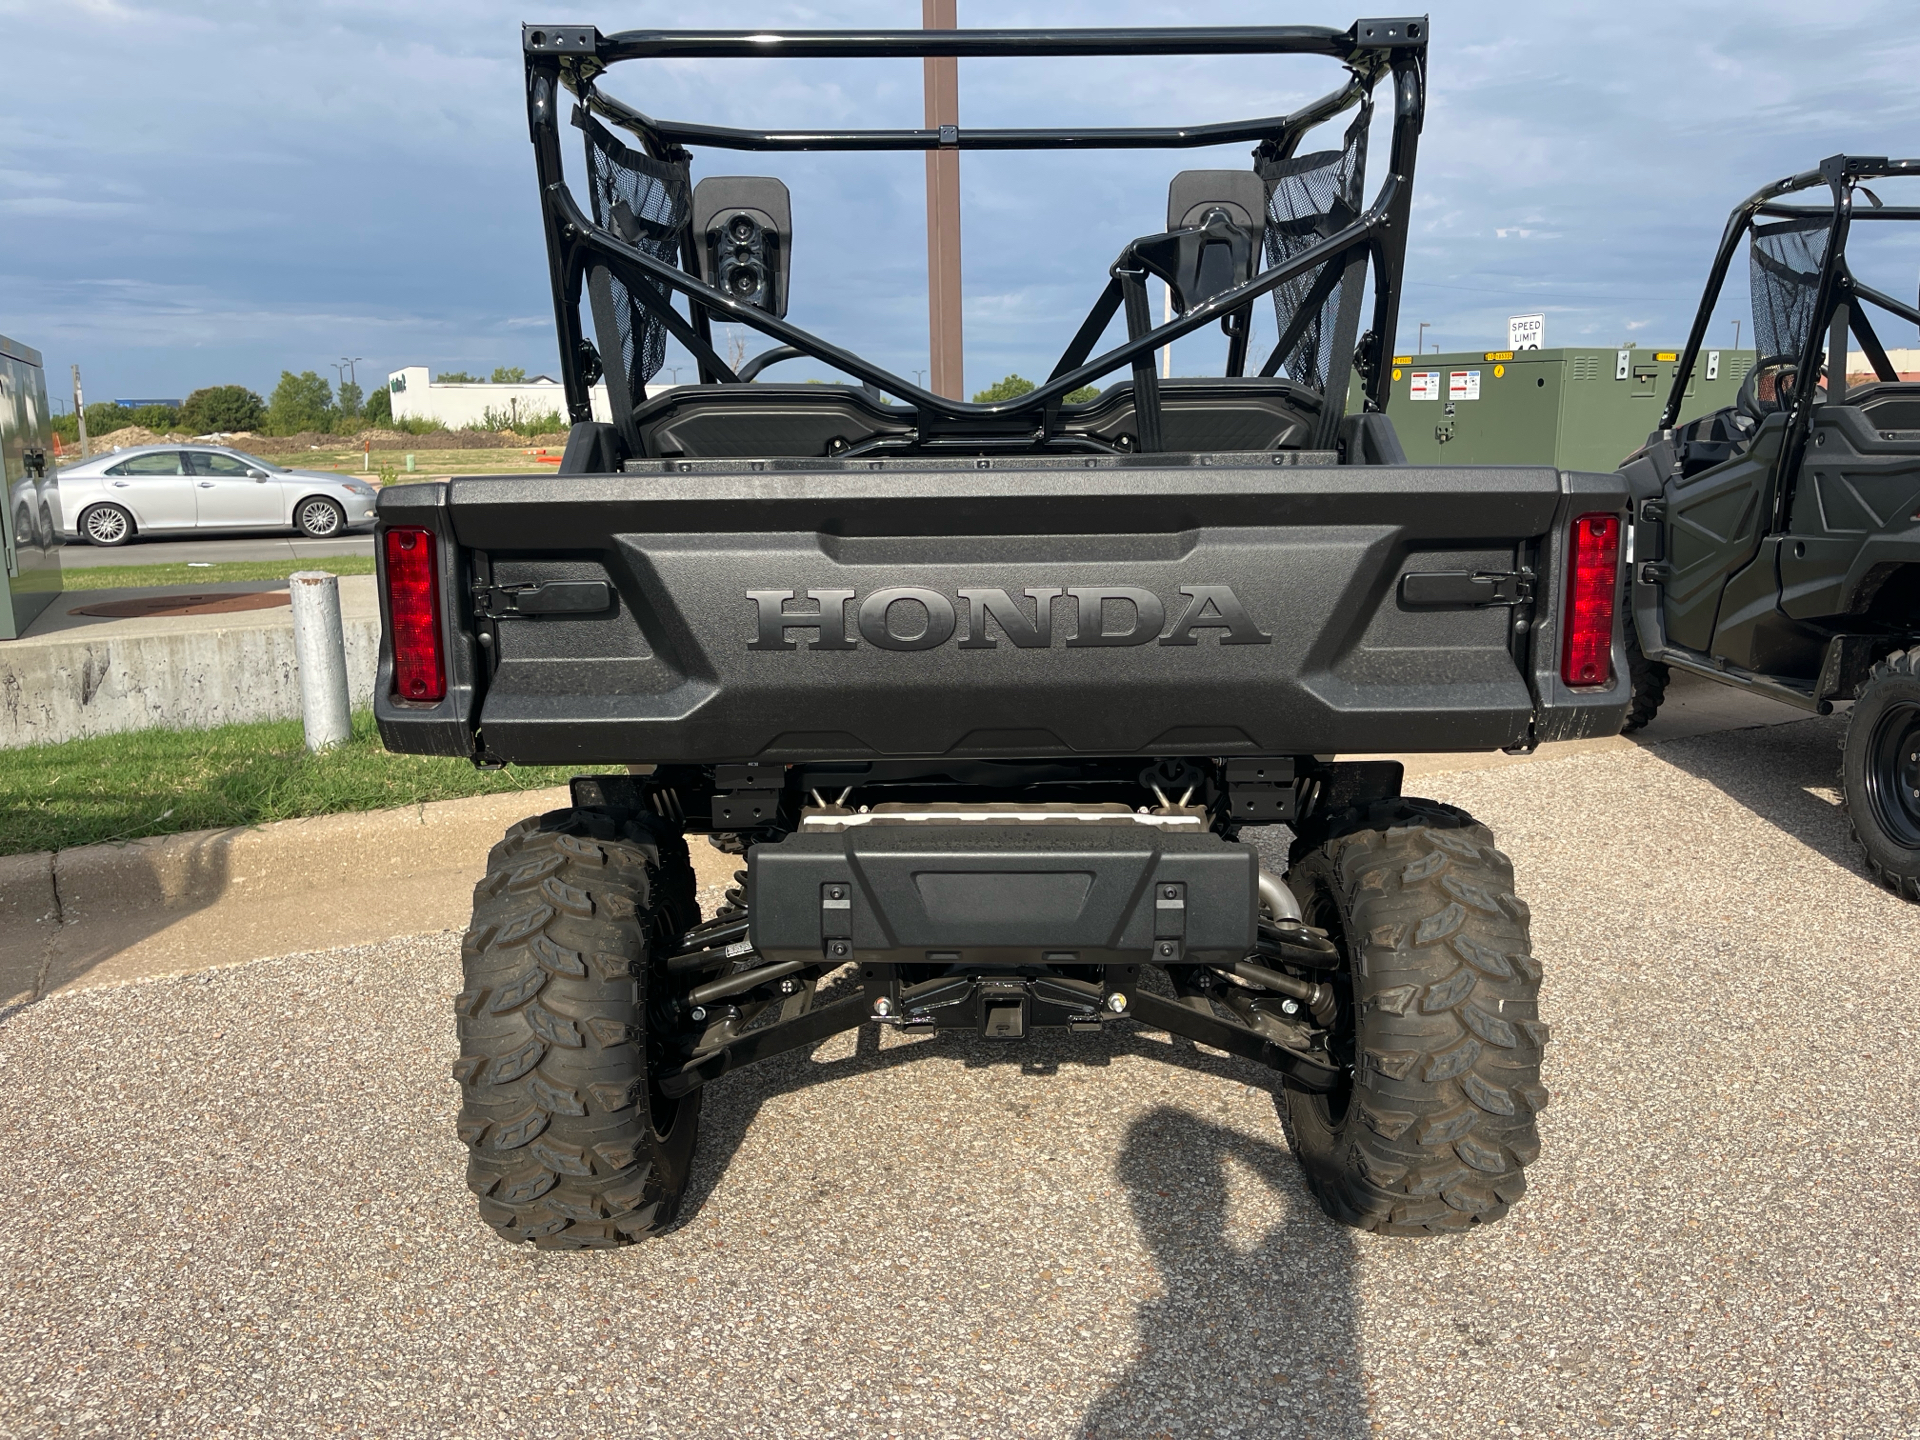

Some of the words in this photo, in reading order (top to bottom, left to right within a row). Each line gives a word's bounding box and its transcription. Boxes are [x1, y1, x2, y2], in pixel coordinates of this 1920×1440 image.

[1512, 321, 1540, 331] SPEED
[1515, 332, 1536, 342] LIMIT
[746, 585, 1272, 651] HONDA
